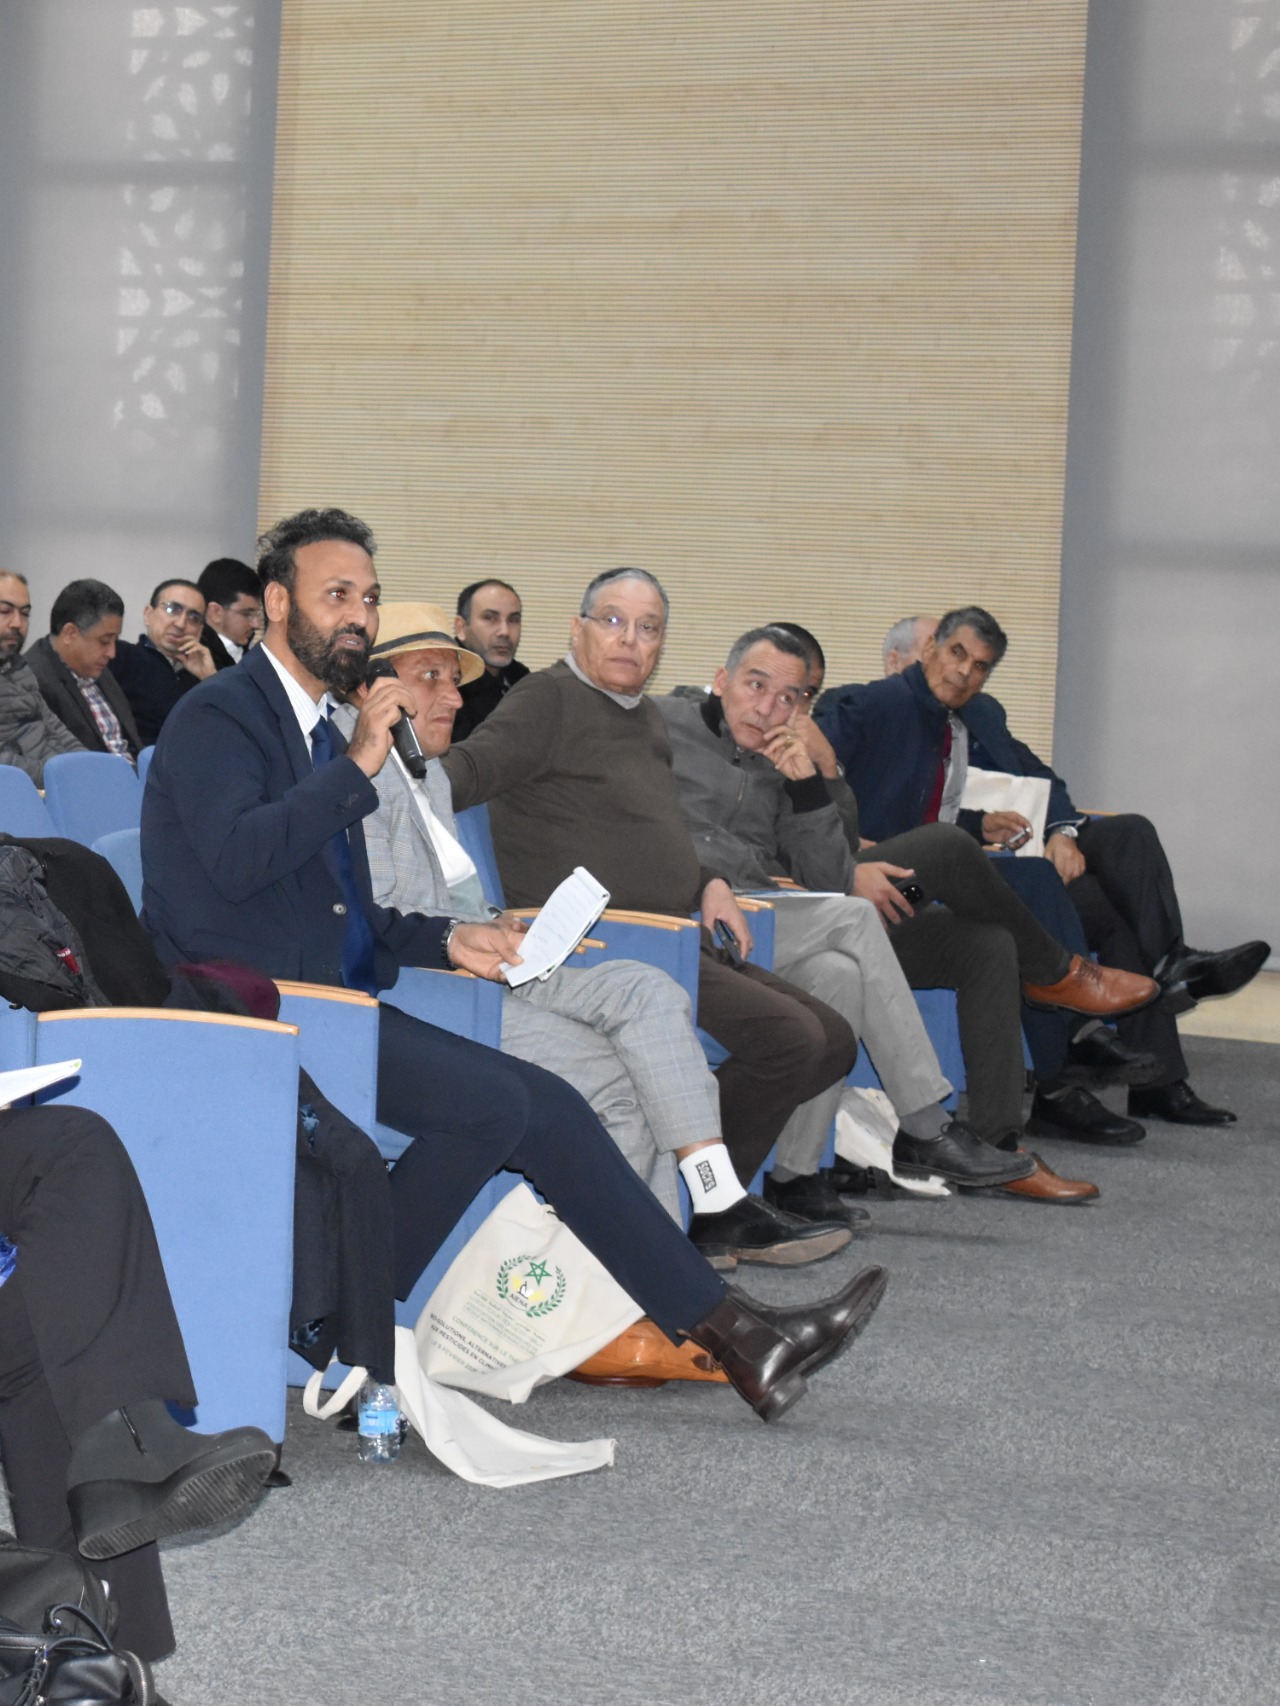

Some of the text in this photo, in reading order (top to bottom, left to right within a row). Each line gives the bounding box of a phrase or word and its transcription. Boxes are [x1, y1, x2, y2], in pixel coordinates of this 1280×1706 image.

[697, 1161, 717, 1192] SOCKS
[509, 1293, 528, 1309] AIENA
[439, 1329, 470, 1354] PESTICIDES
[470, 1352, 479, 1360] EN
[489, 1340, 500, 1352] SUR
